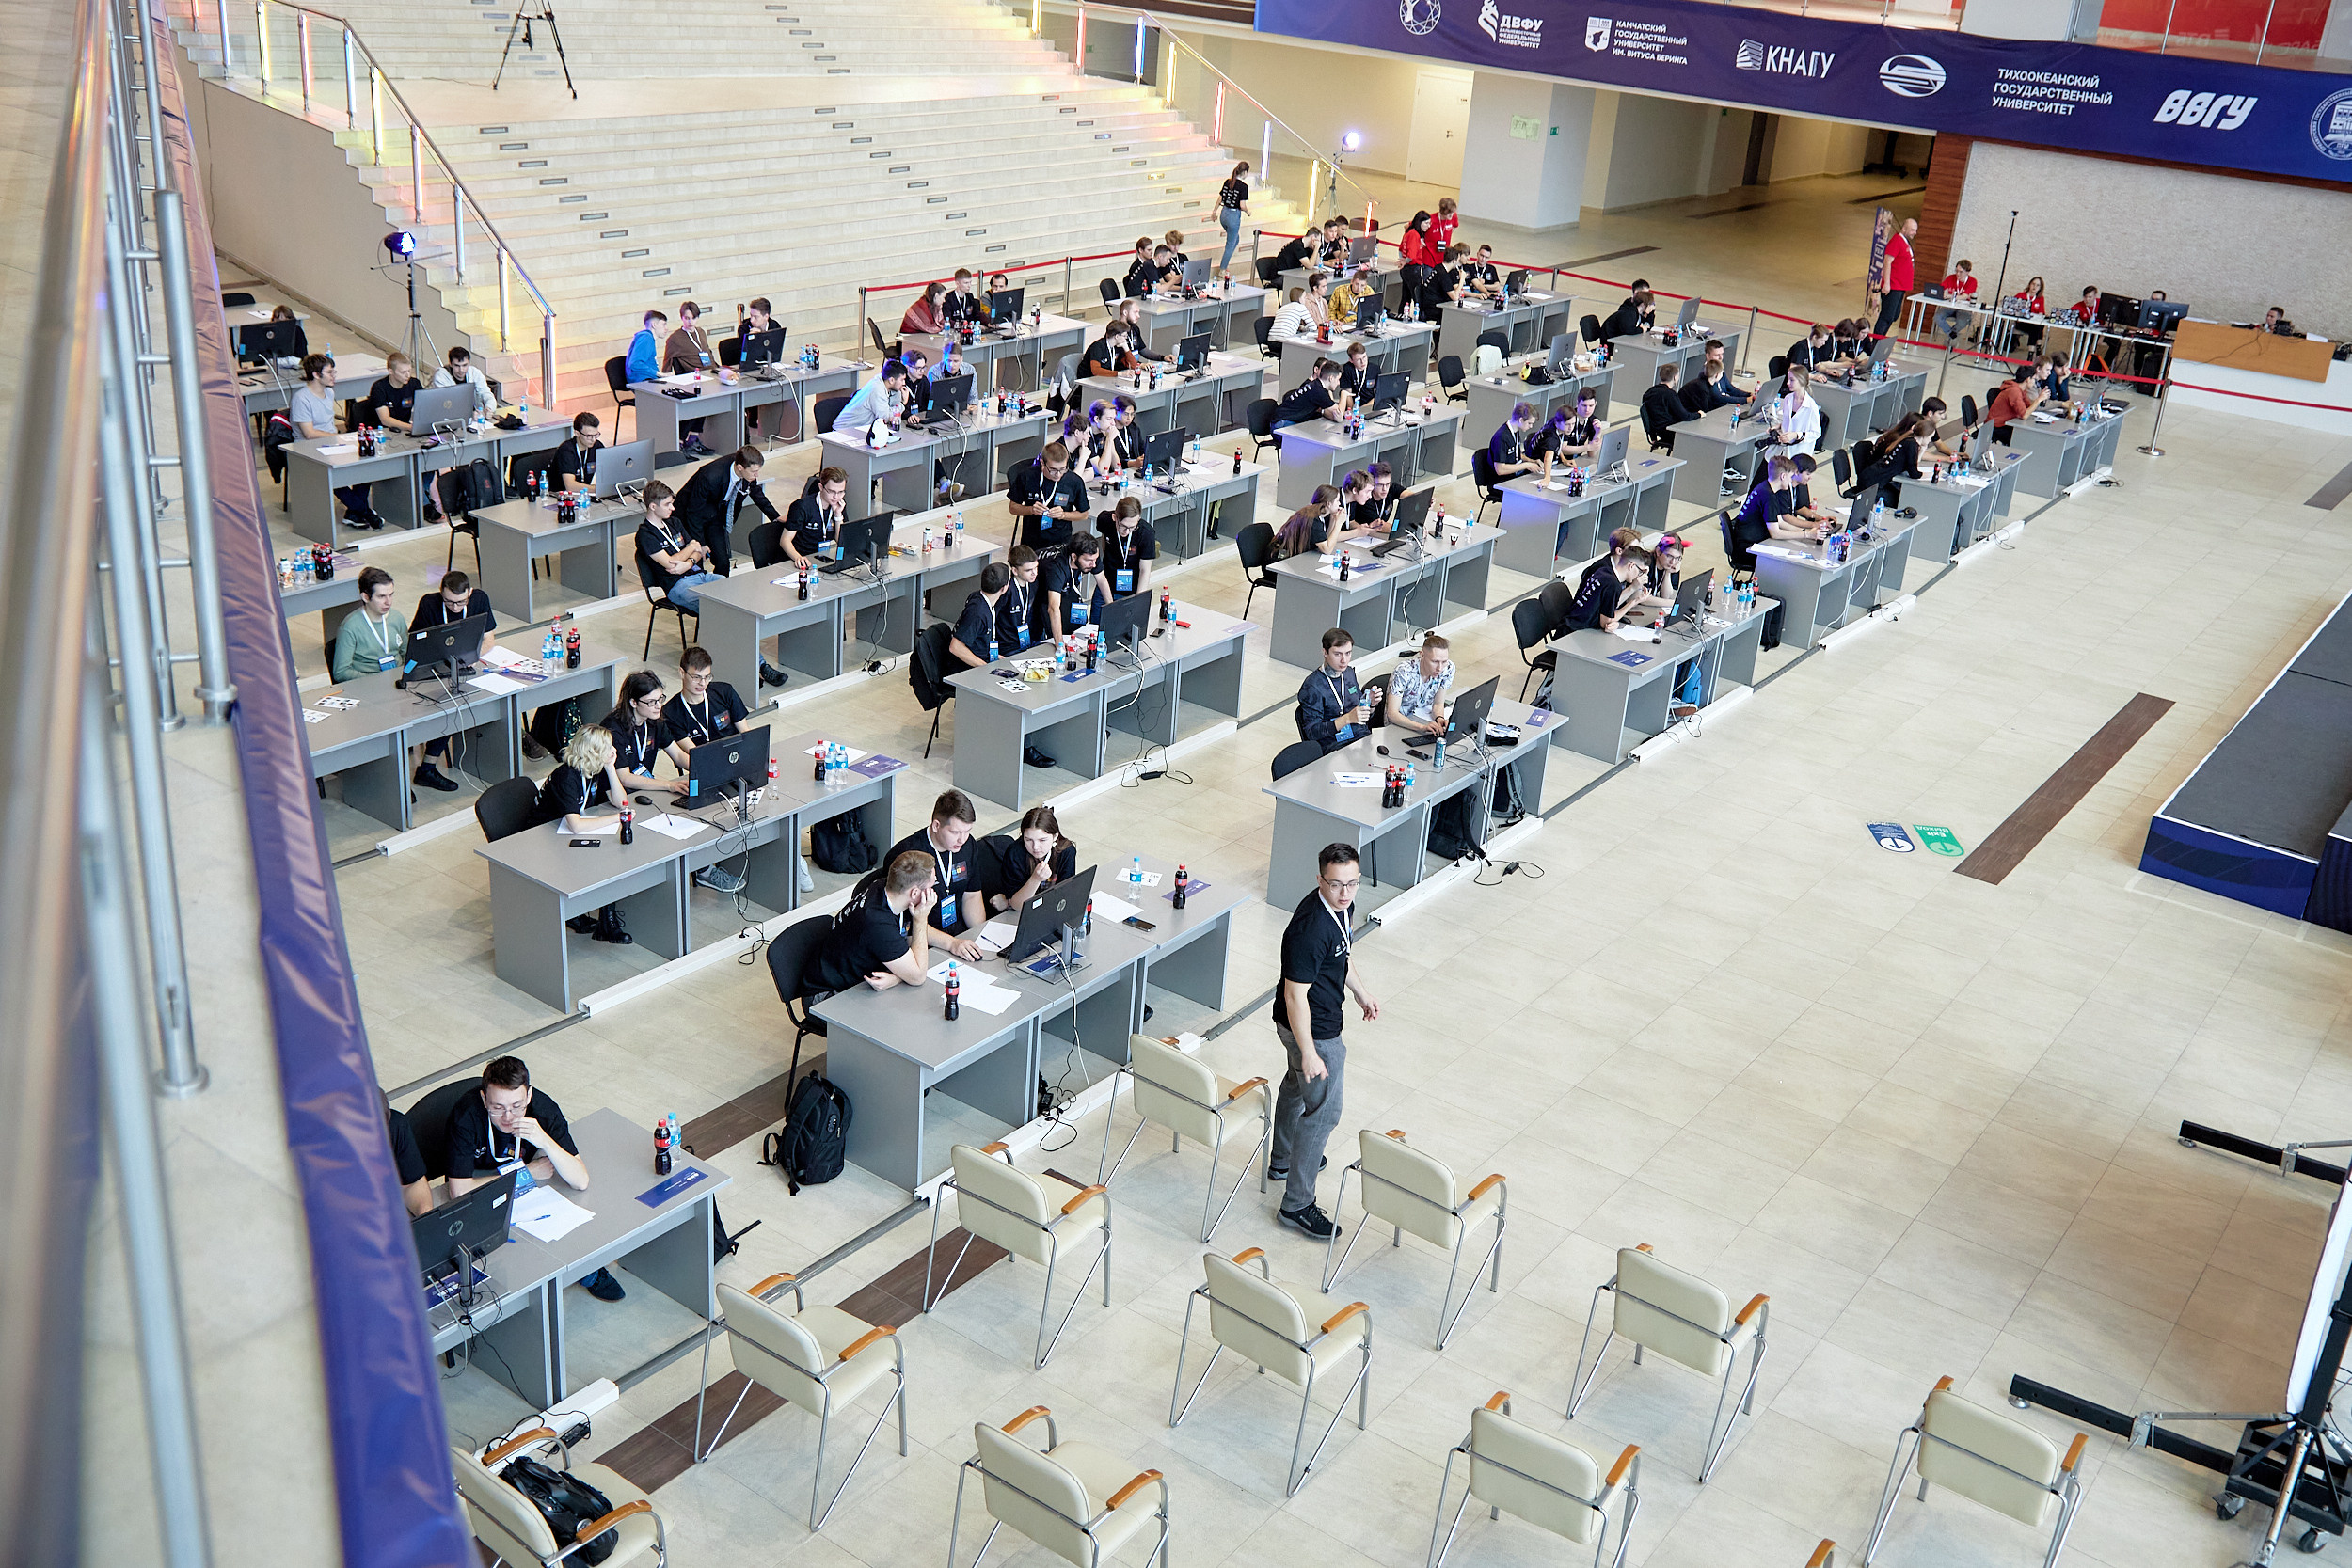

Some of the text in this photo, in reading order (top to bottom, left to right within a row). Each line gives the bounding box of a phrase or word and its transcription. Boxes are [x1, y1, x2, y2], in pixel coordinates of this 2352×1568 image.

[1500, 14, 1543, 32] ДВФУ
[1615, 20, 1667, 34] КАМЧАТСКИЙ
[1498, 32, 1541, 42] ФЕДЕРАЛЬНЫЙ
[1498, 38, 1540, 49] УНИВЕРСИТЕТ
[1613, 39, 1664, 52] УНИВЕРСИТЕТ
[1614, 29, 1688, 46] ГОСУДАРСТВЕННЫЙ
[1612, 47, 1688, 65] ИМ. ВИТУСА БЕРИНГА
[1765, 44, 1836, 79] КНАГУ
[1997, 68, 2100, 88] ТИХООКЕАНСКИЙ
[1994, 82, 2113, 105] ГОСУДАРСТВЕННЫЙ
[1992, 96, 2075, 116] УНИВЕРСИТЕТ
[2153, 89, 2258, 130] ВВГУ
[728, 752, 739, 763] hp
